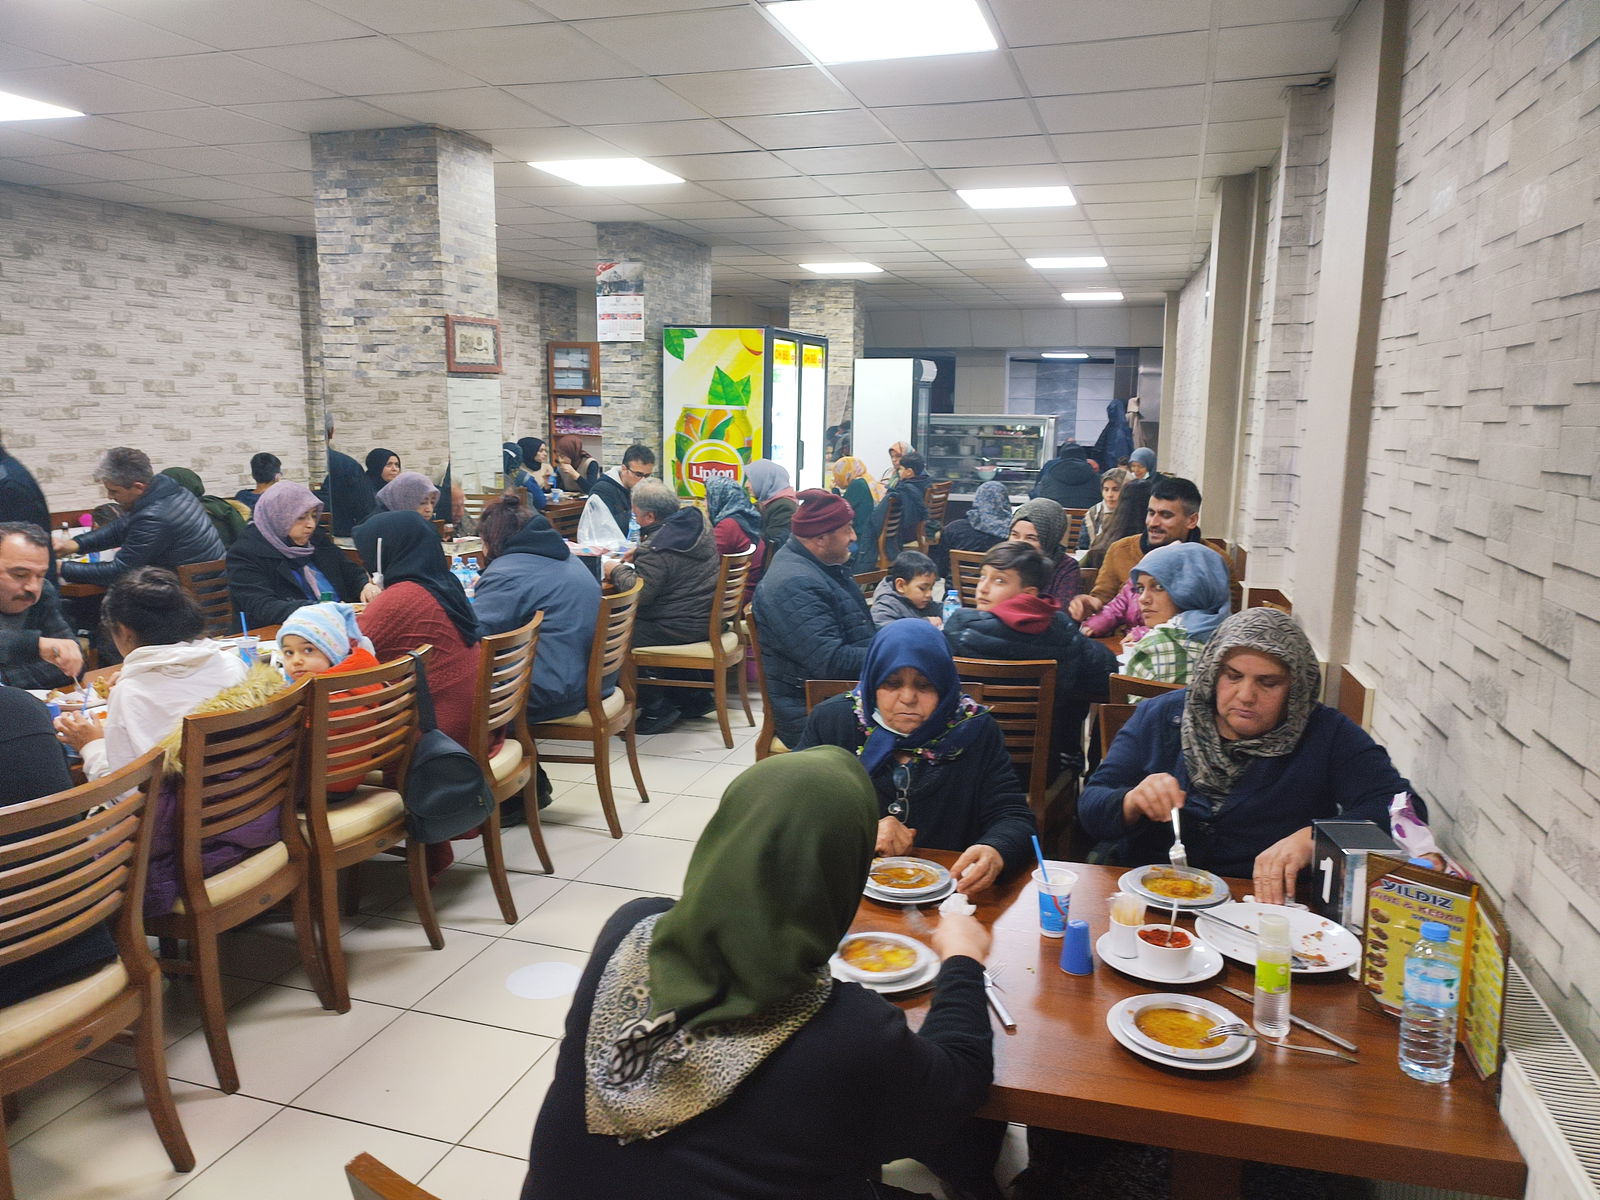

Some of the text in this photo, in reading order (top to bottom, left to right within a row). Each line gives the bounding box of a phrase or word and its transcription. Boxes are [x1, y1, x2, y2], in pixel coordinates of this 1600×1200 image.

[691, 464, 735, 482] Lipton
[1319, 856, 1334, 904] 1
[1381, 879, 1454, 911] YILDIZ
